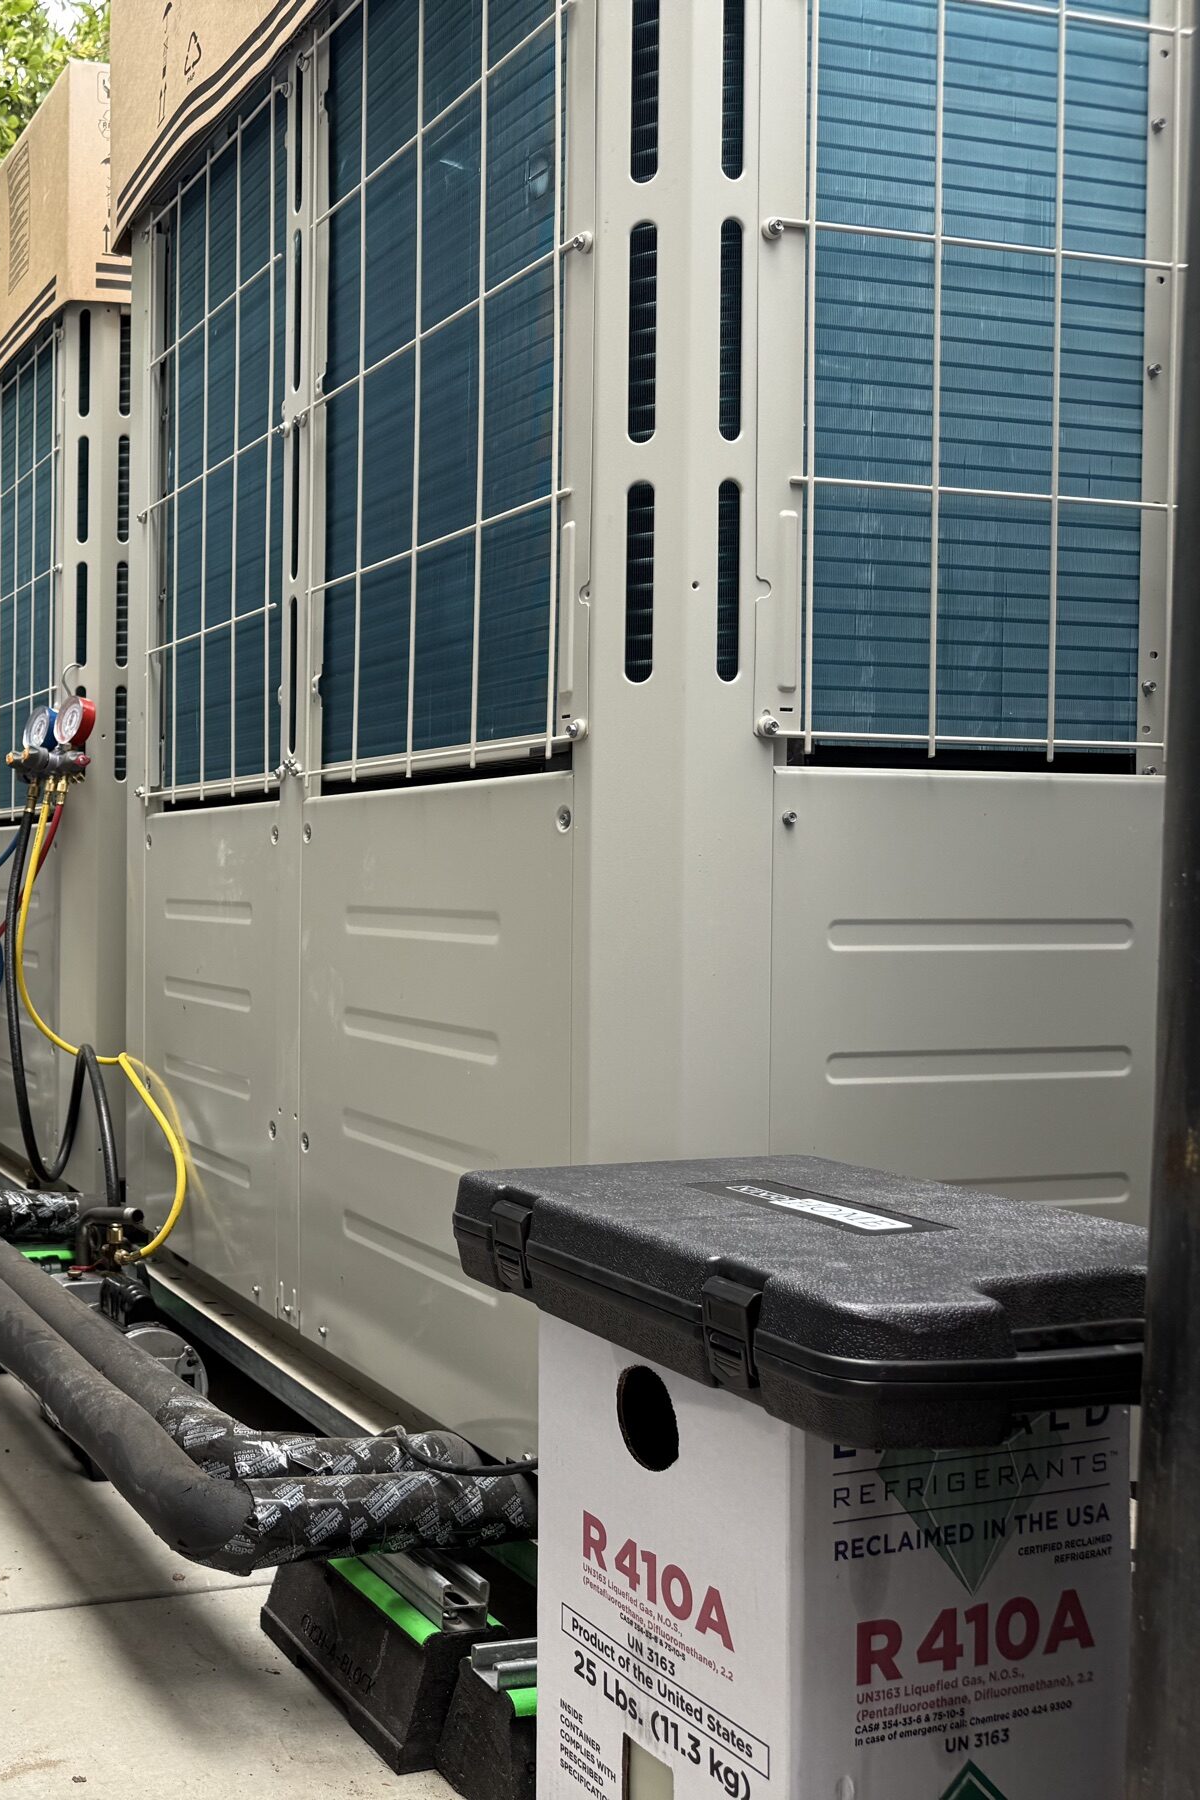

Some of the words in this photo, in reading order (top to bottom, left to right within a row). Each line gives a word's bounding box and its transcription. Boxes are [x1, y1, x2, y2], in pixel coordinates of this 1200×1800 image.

[834, 1522, 975, 1561] RECLAIMED
[983, 1517, 1006, 1541] IN
[1014, 1509, 1059, 1535] THE
[1066, 1502, 1111, 1528] USA
[1017, 1541, 1063, 1557] CERTIFIED
[1064, 1533, 1113, 1550] RECLAIMED
[1054, 1545, 1113, 1565] REFRIGERANT
[582, 1562, 607, 1586] UN3163
[607, 1579, 638, 1607] Liquefied
[639, 1602, 656, 1621] Gas,
[626, 1632, 644, 1658] UN
[646, 1647, 676, 1677] 3163
[720, 1665, 735, 1682] 2.2
[572, 1616, 616, 1663] Product
[618, 1655, 631, 1673] of
[632, 1663, 654, 1691] the
[657, 1679, 704, 1726] United
[706, 1713, 754, 1759] States
[856, 1688, 901, 1706] UN3163
[903, 1678, 959, 1699] Liquefied
[962, 1674, 987, 1688] Gas,
[1077, 1670, 1095, 1684] 2.2
[559, 1697, 584, 1725] INSIDE
[573, 1649, 598, 1688] 25
[603, 1670, 644, 1726] Lbs.
[650, 1710, 702, 1766] (11.3
[708, 1746, 751, 1800] kg)
[855, 1721, 880, 1736] CAS#
[865, 1734, 887, 1747] case
[899, 1723, 948, 1741] emergency
[969, 1712, 1011, 1728] Chemtrec
[1012, 1708, 1030, 1720] 800
[1031, 1703, 1049, 1716] 424
[1050, 1699, 1074, 1713] 9300
[559, 1713, 601, 1755] CONTAINER
[944, 1735, 970, 1754] UN
[973, 1728, 1011, 1750] 3163
[559, 1728, 596, 1765] COMPLIES
[595, 1757, 617, 1784] WITH
[559, 1742, 604, 1787] PRESCRIBED
[559, 1757, 611, 1800] SPECIFICATIO
